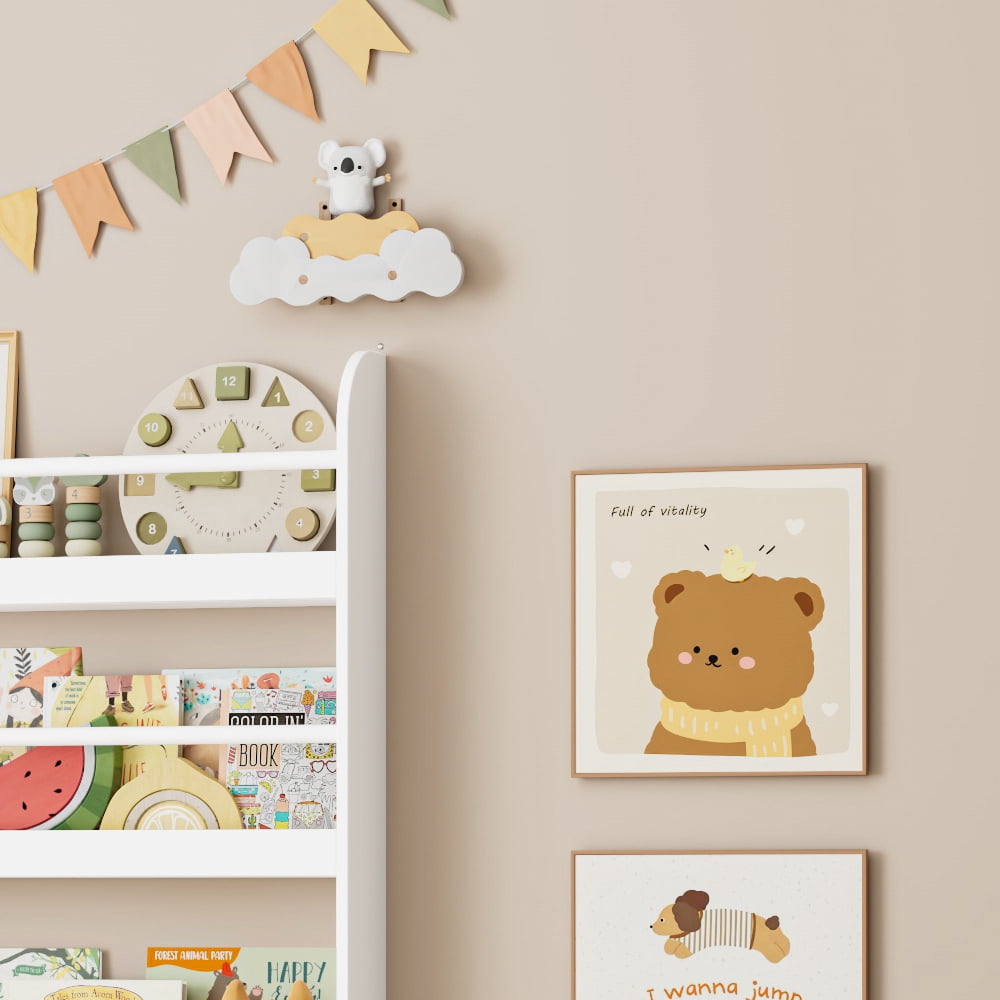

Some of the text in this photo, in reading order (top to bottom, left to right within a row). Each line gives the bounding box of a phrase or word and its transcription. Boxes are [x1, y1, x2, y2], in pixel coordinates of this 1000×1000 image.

[222, 375, 237, 387] 12
[274, 392, 281, 403] 1
[144, 422, 159, 433] 10
[304, 420, 314, 432] 2
[136, 474, 145, 487] 9
[312, 469, 320, 480] 3
[71, 489, 78, 499] 4
[610, 503, 708, 519] Full of vitality
[148, 523, 157, 535] 8
[238, 743, 279, 767] BOOK
[154, 950, 233, 961] FOREST ANIMAL PARTY
[267, 961, 327, 984] HAPPY
[71, 988, 89, 999] from
[91, 988, 113, 1000] Acorn
[663, 981, 739, 1000] wanna
